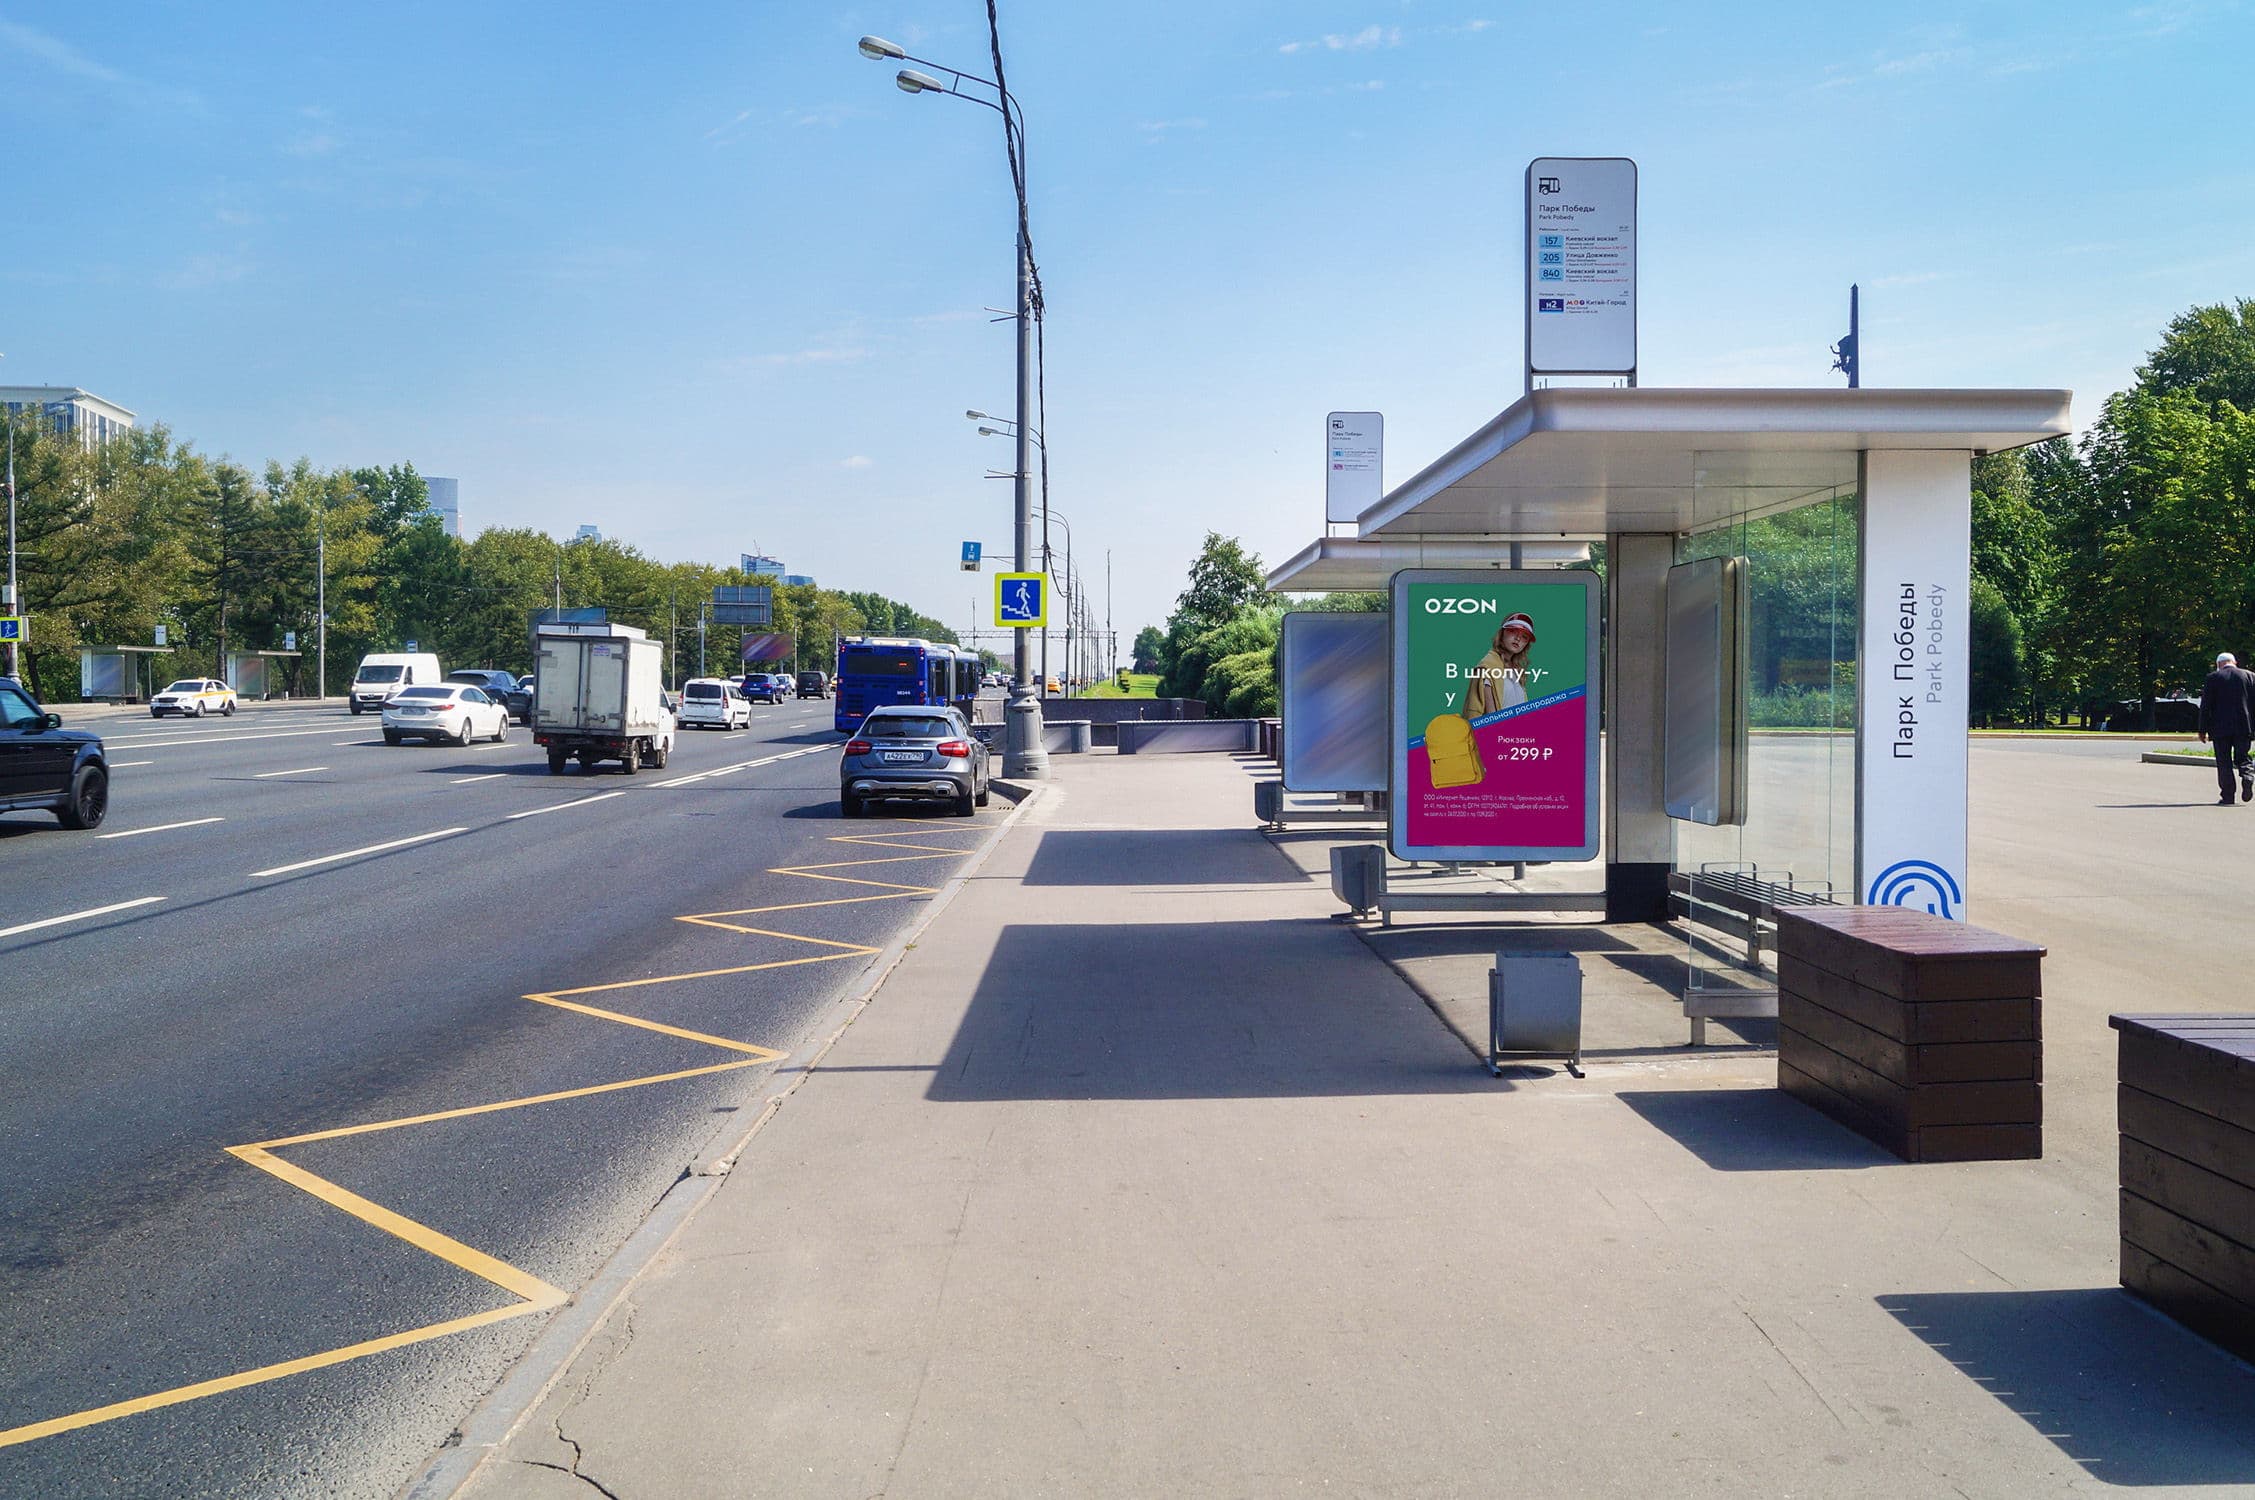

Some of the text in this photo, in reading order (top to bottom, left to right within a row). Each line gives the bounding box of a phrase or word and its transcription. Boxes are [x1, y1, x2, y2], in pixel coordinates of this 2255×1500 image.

[1539, 204, 1595, 213] Парк Победы
[1545, 237, 1558, 245] 157
[1543, 253, 1560, 261] 205
[1543, 269, 1560, 277] 840
[1425, 598, 1497, 614] OZON
[1926, 584, 1947, 703] Park Pobedy
[1446, 663, 1548, 683] В школу-у-
[1893, 583, 1918, 758] Парк Победы
[1445, 692, 1456, 707] у
[1472, 692, 1567, 727] школьная распродажа
[1498, 735, 1535, 744] Рюкзаки
[1510, 747, 1539, 761] 299
